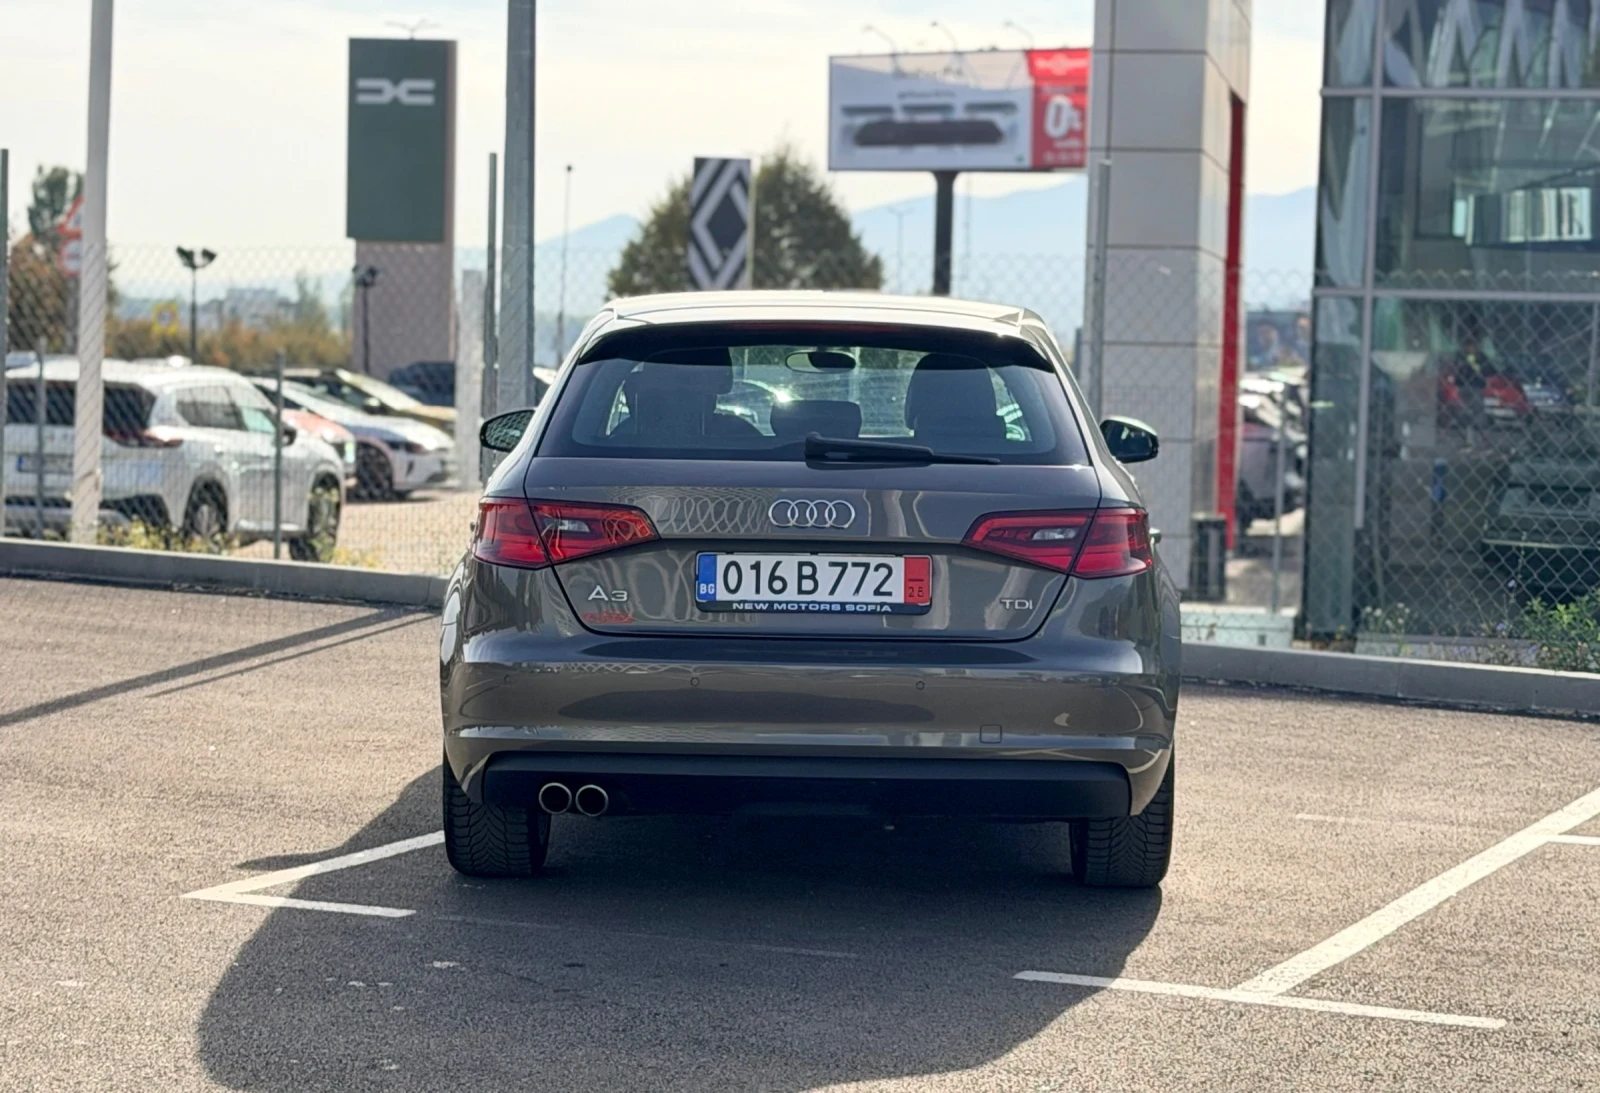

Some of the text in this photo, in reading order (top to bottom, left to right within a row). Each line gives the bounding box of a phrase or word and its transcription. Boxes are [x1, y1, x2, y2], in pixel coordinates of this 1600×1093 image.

[587, 585, 628, 602] A3
[700, 583, 715, 595] BG
[732, 602, 892, 612] NEW MOTORS SOFIA
[1000, 599, 1033, 610] TDI
